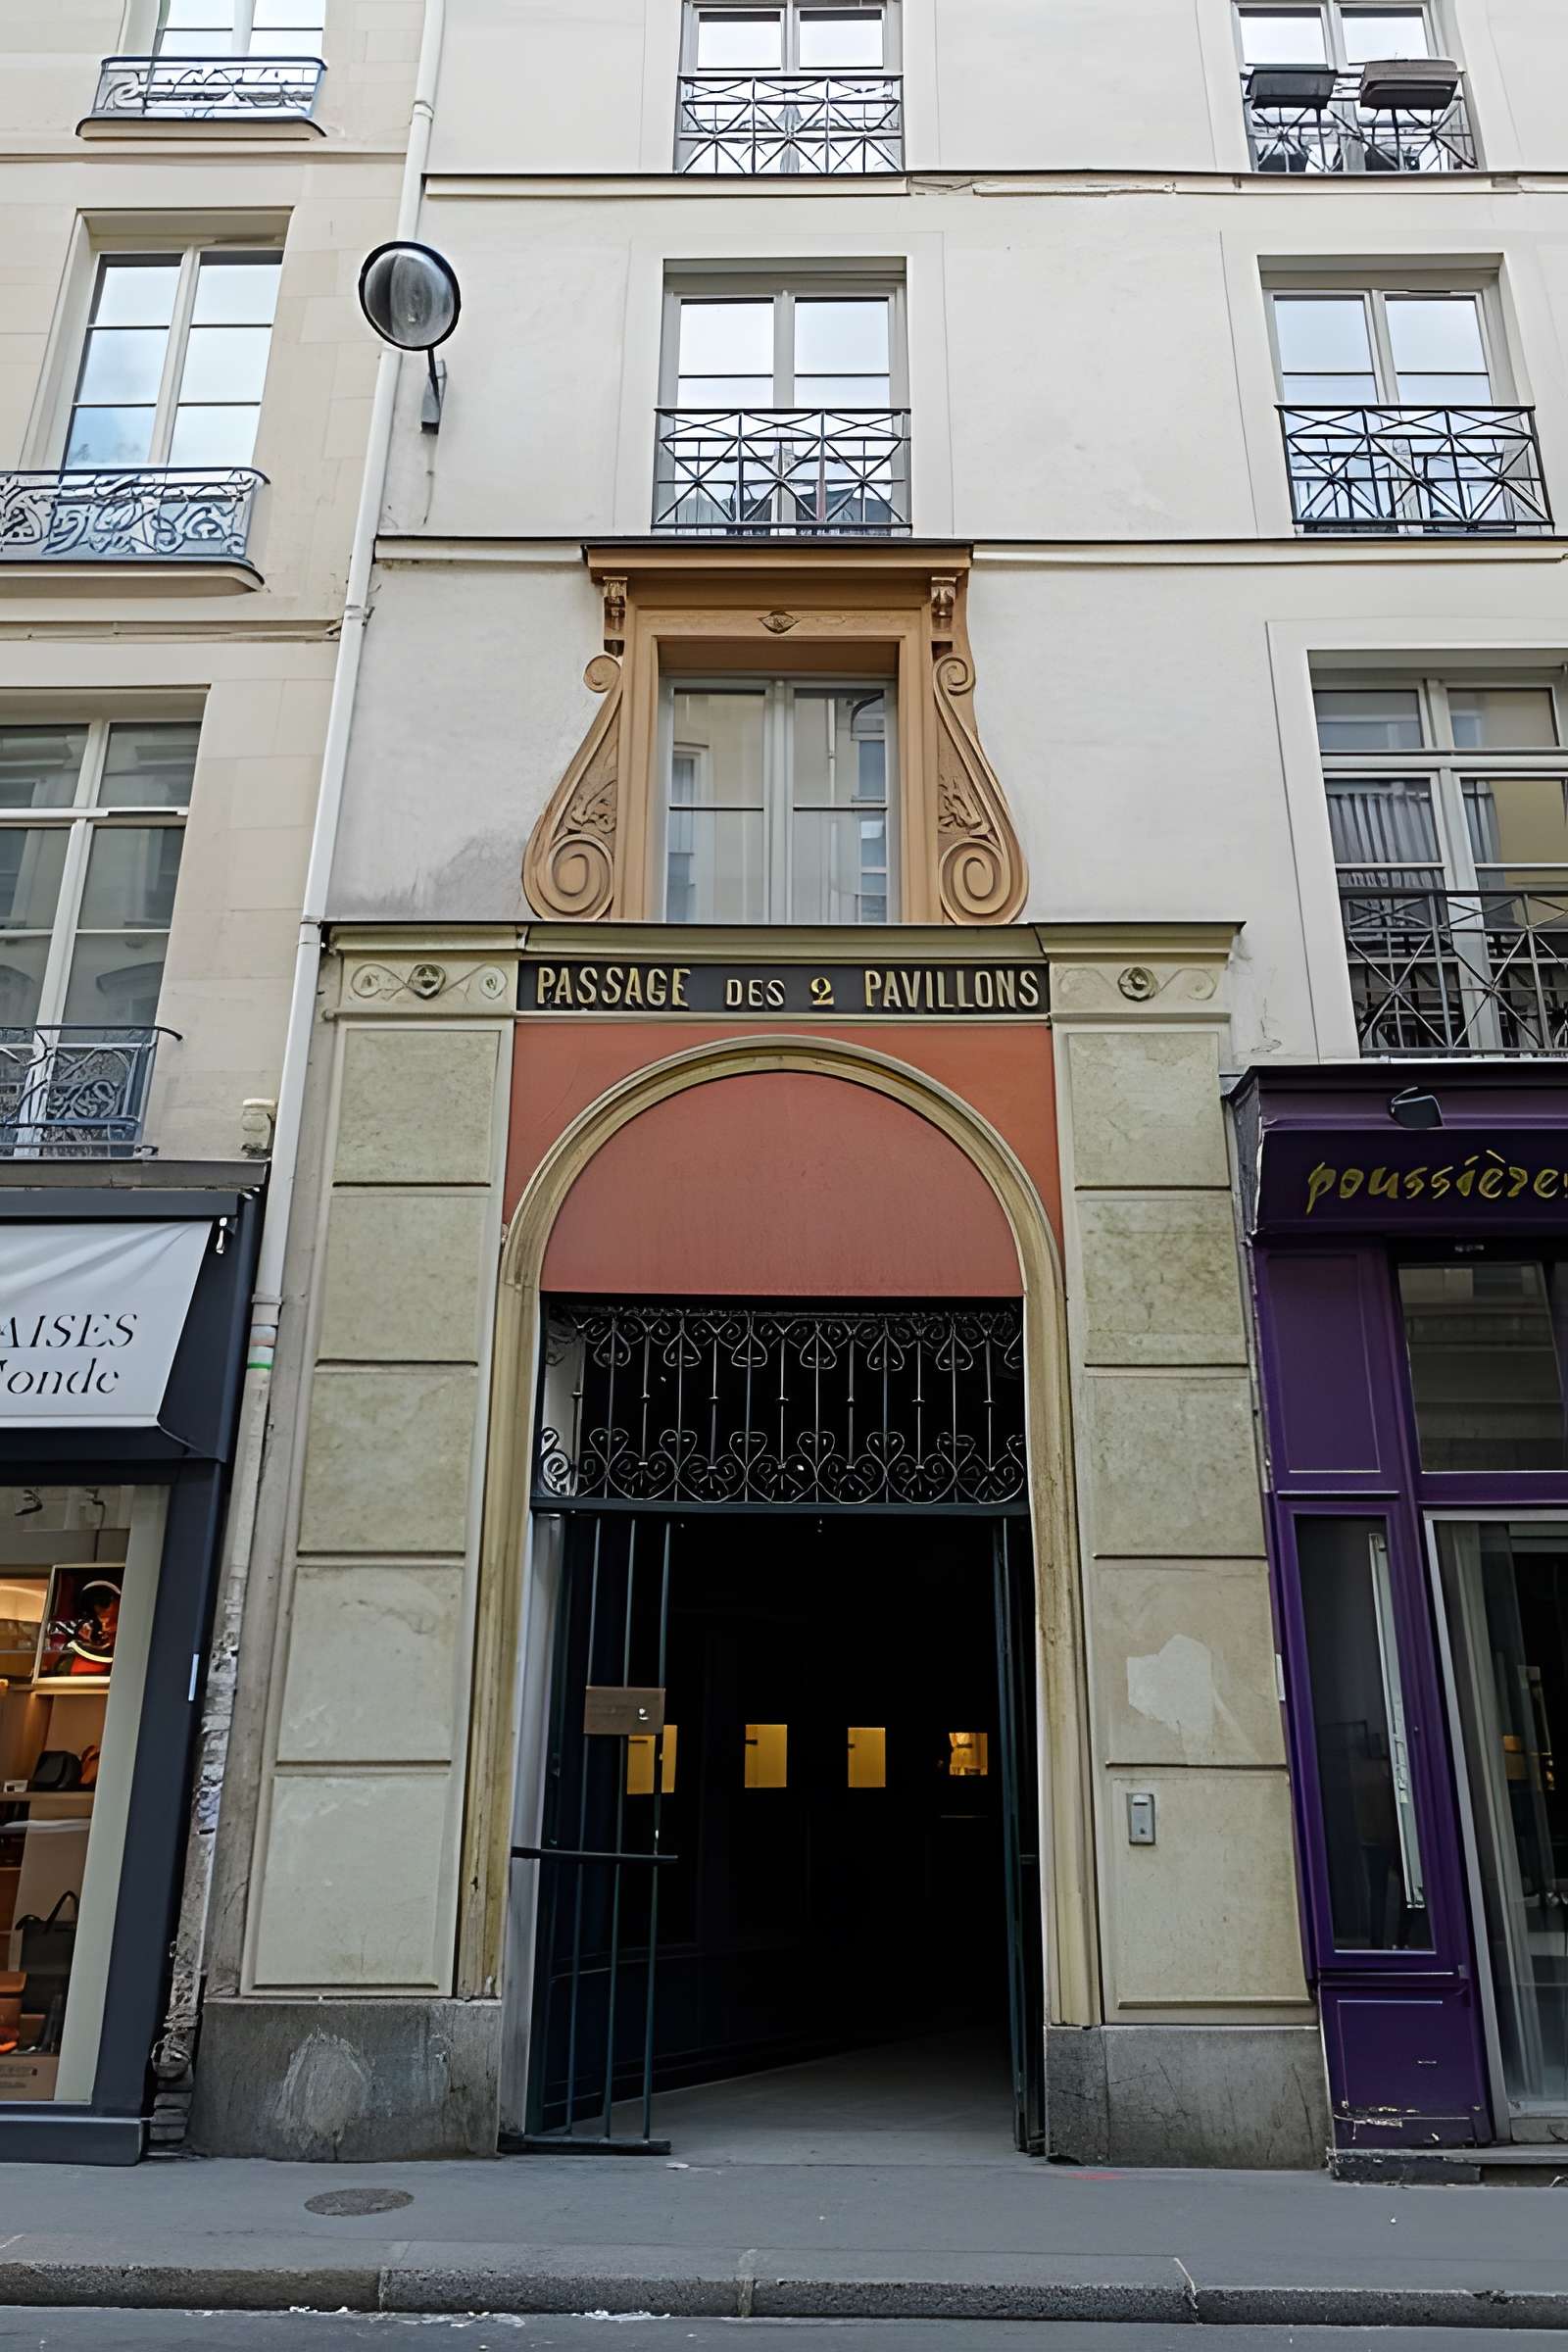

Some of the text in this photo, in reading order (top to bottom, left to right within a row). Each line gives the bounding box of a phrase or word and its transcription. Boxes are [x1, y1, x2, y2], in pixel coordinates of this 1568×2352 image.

[536, 966, 1039, 1008] PASSAGE DES 2 PAVILLONS
[1305, 1149, 1568, 1215] poussière
[0, 1357, 120, 1395] onde
